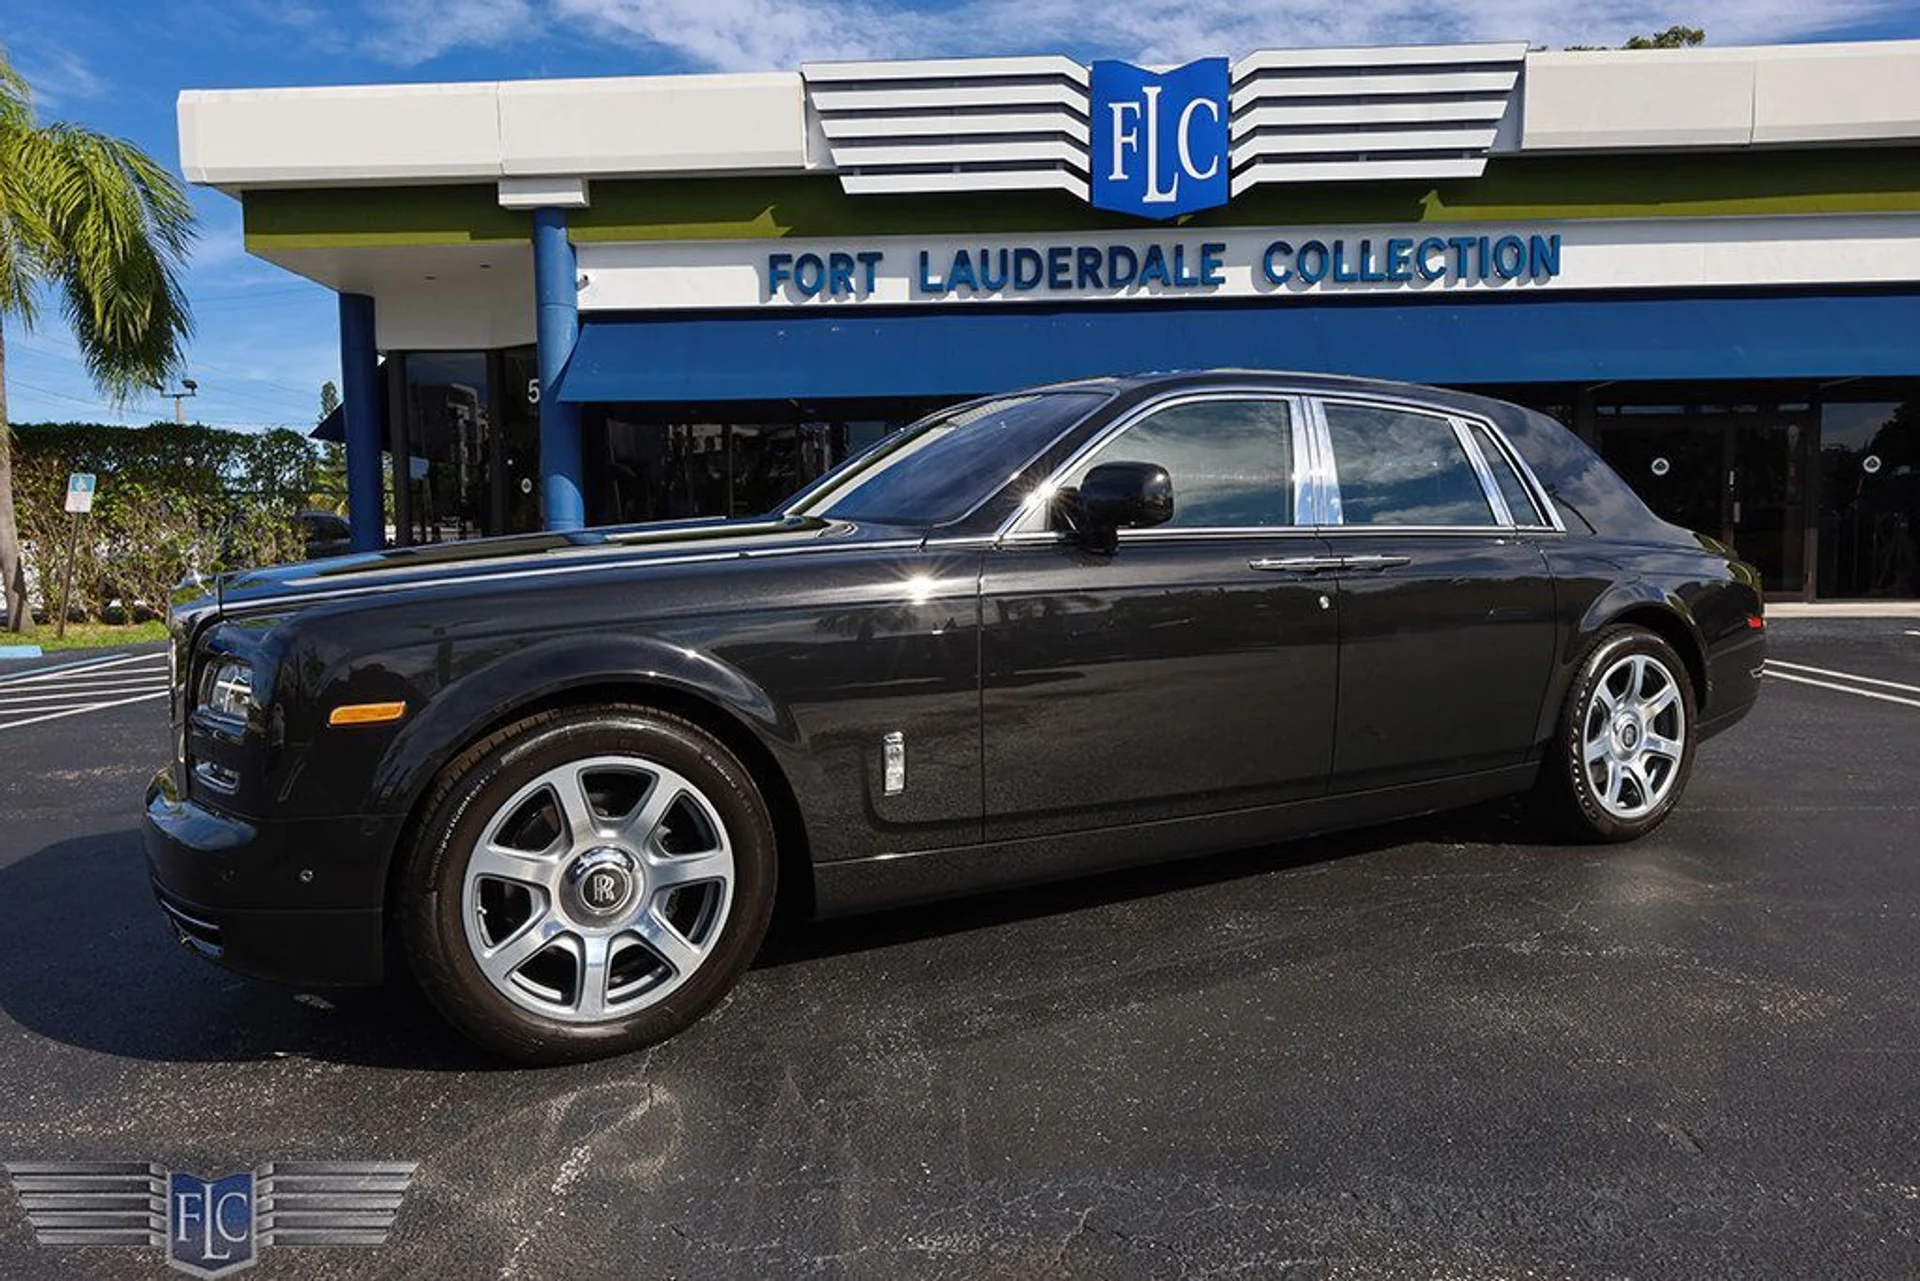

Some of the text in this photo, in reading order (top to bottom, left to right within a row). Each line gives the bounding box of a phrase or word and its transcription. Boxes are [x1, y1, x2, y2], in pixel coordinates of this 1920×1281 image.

[1108, 86, 1218, 203] FLC
[768, 233, 1561, 296] FORT LAUDERDALE COLLECTION
[528, 379, 540, 404] 5
